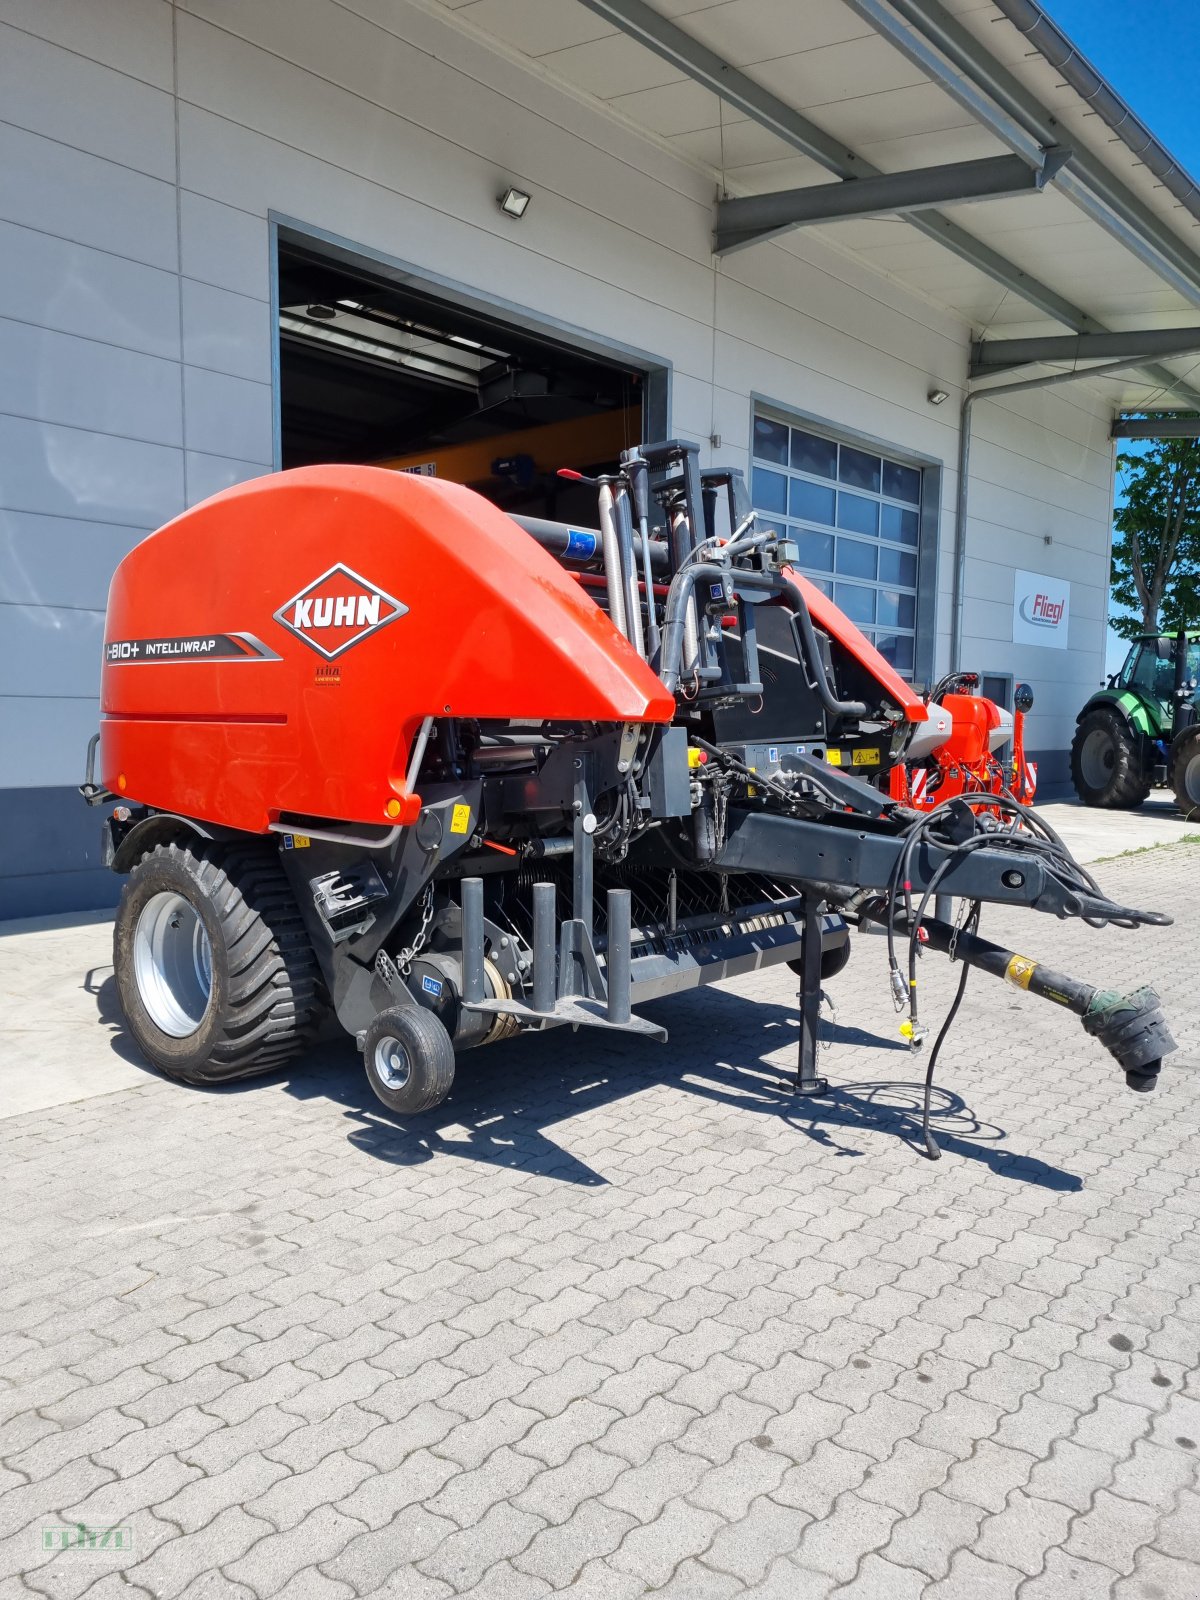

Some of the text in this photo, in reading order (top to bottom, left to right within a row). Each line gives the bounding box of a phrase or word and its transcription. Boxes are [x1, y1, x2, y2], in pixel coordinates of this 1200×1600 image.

[293, 595, 380, 628] KUHN
[1032, 594, 1065, 624] Fliegl
[145, 640, 216, 655] INTELLIWRAP
